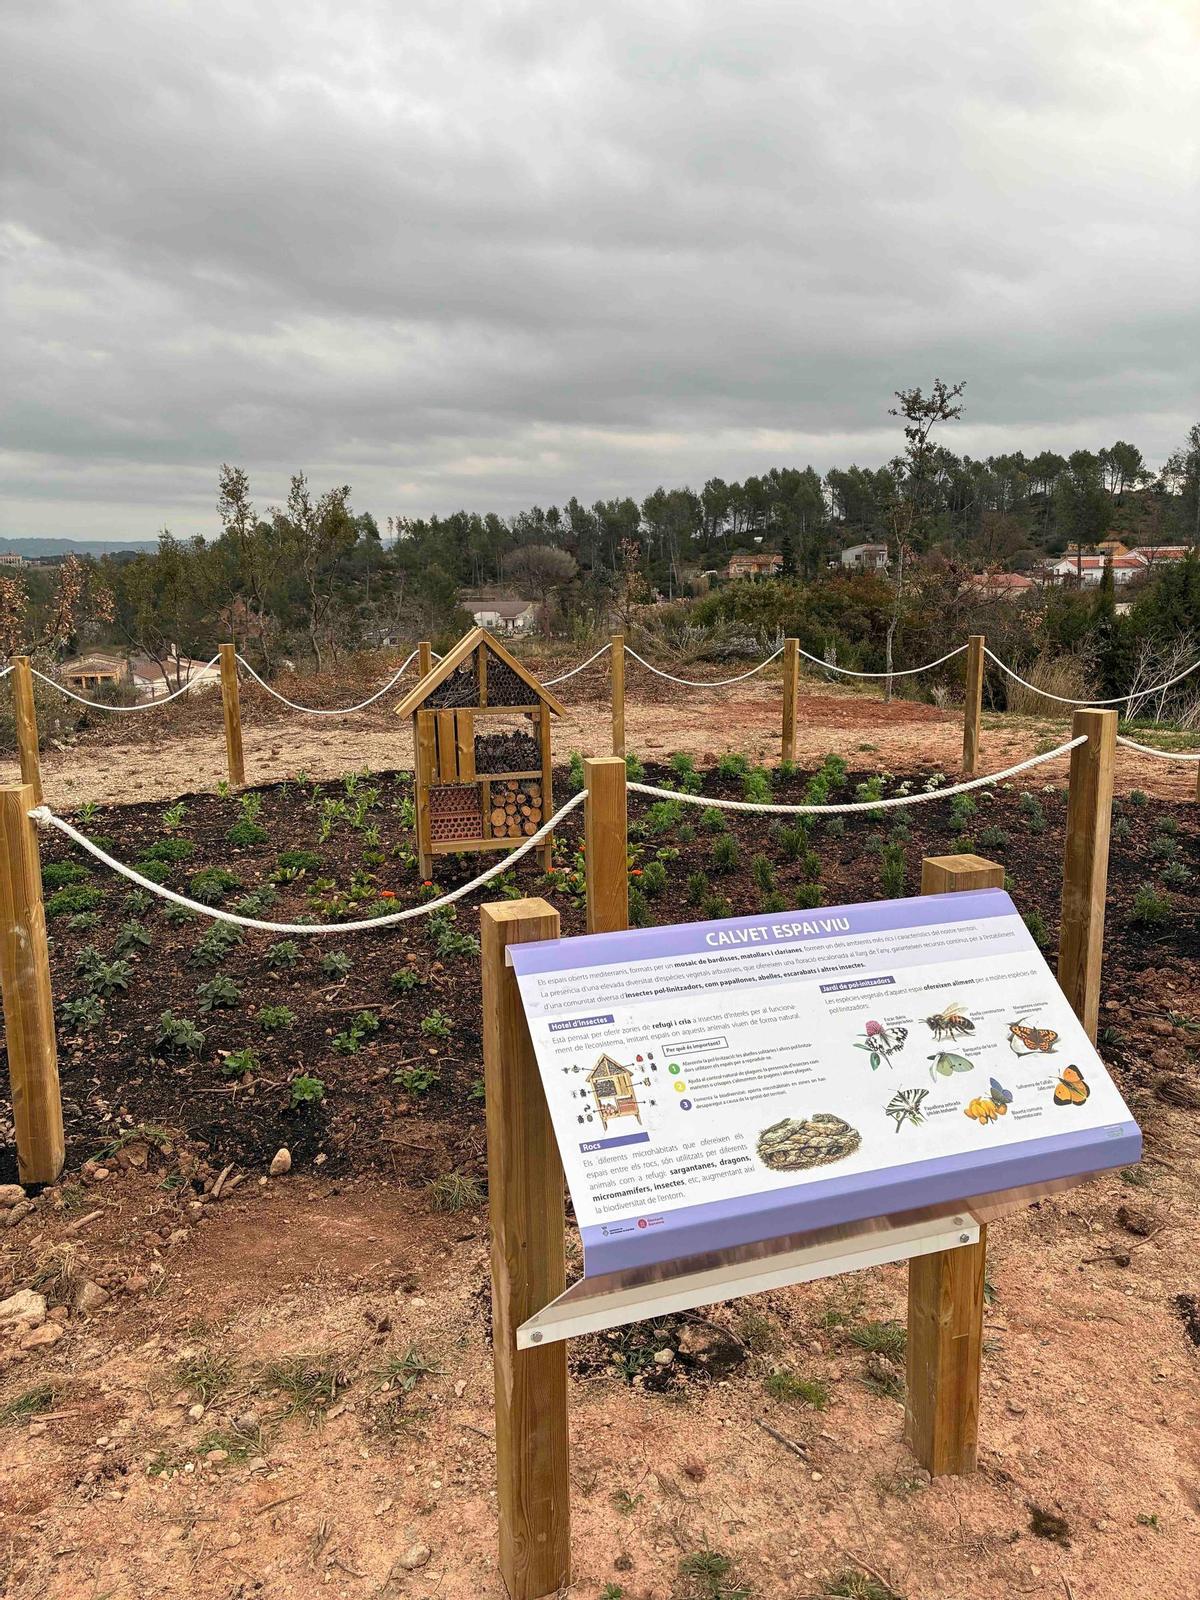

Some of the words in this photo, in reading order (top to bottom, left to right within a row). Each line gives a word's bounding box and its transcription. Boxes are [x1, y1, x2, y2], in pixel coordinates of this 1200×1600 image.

[706, 926, 768, 946] CALVET
[772, 920, 819, 939] ESPAI
[819, 917, 850, 932] VIU
[547, 977, 567, 985] espais
[707, 956, 741, 964] bardisses,
[625, 978, 653, 986] diversitat
[686, 971, 712, 979] vegetals
[817, 953, 849, 961] escalonada
[563, 998, 596, 1007] comunitat
[720, 978, 758, 987] papallones,
[783, 969, 817, 977] escarabats
[860, 992, 884, 1000] vegetals
[551, 1022, 571, 1030] Hotel
[567, 1033, 590, 1043] pensat
[652, 1021, 674, 1029] refugi
[650, 1033, 671, 1041] espais
[681, 1028, 706, 1036] aquests
[707, 1024, 731, 1032] animals
[586, 1170, 608, 1179] espais
[676, 1153, 704, 1162] utilitzats
[719, 1145, 748, 1155] diferents
[597, 1155, 628, 1164] diferents
[683, 1143, 696, 1152] que
[700, 1137, 731, 1146] ofereixen
[589, 1180, 616, 1190] animals
[670, 1163, 718, 1175] sargantanes,
[719, 1157, 752, 1166] dragons,
[702, 1169, 743, 1182] augmentant
[603, 1199, 646, 1212] biodiversitat
